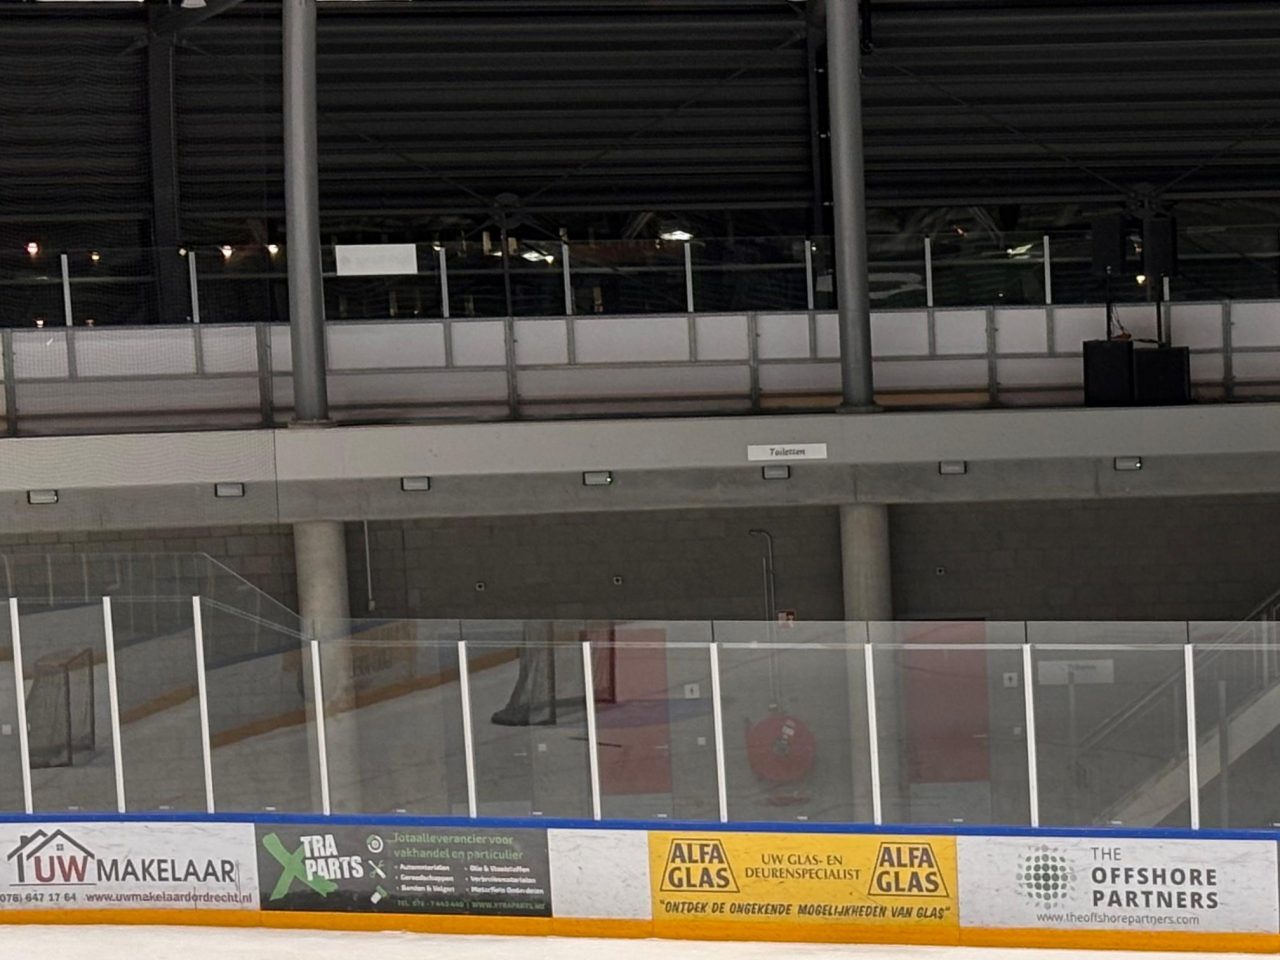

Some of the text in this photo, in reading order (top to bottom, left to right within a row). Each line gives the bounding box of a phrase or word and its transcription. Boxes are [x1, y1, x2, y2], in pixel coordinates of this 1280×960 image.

[489, 835, 514, 845] voor
[394, 848, 524, 861] vakhandel en particulier
[670, 842, 725, 864] ALFA
[761, 853, 842, 866] UW GLAS- EN
[879, 846, 934, 868] ALFA
[1090, 847, 1121, 861] THE
[33, 856, 88, 882] UW
[96, 858, 236, 882] MAKELAAR
[305, 855, 364, 881] PARTS
[745, 867, 862, 881] DEURENSPECIALIST
[1091, 867, 1217, 886] OFFSHORE
[667, 867, 730, 889] GLAS
[876, 870, 939, 892] GLAS
[85, 892, 253, 904] www.uwmakelaardordrecht.nl
[1093, 890, 1219, 909] PARTNERS
[711, 902, 726, 914] DE
[730, 903, 791, 915] ONGEKENDE
[797, 904, 887, 917] MOGELIJKHEDEN
[891, 906, 913, 918] VAN
[1036, 912, 1200, 926] www.theoffshorepartners.com
